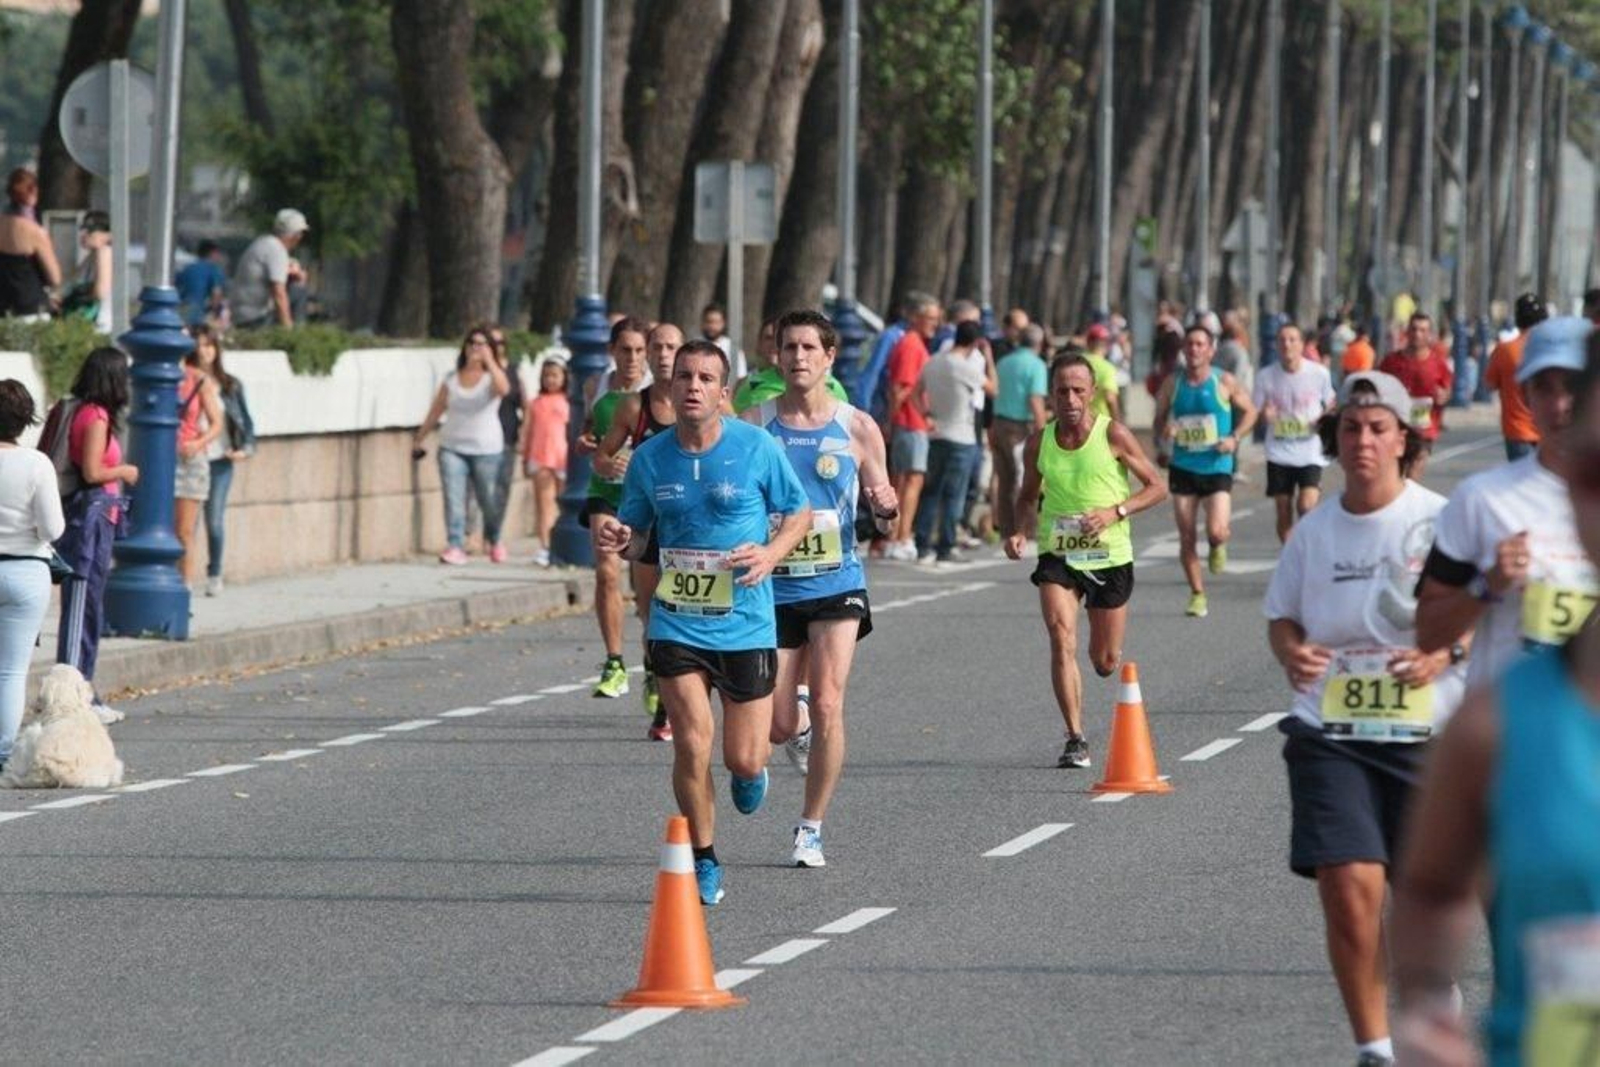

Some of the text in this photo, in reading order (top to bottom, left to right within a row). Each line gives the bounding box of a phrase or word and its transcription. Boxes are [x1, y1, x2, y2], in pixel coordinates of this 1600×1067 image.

[788, 533, 826, 556] 41
[1056, 532, 1102, 551] 1062
[672, 573, 716, 597] 907
[1344, 679, 1409, 709] 811
